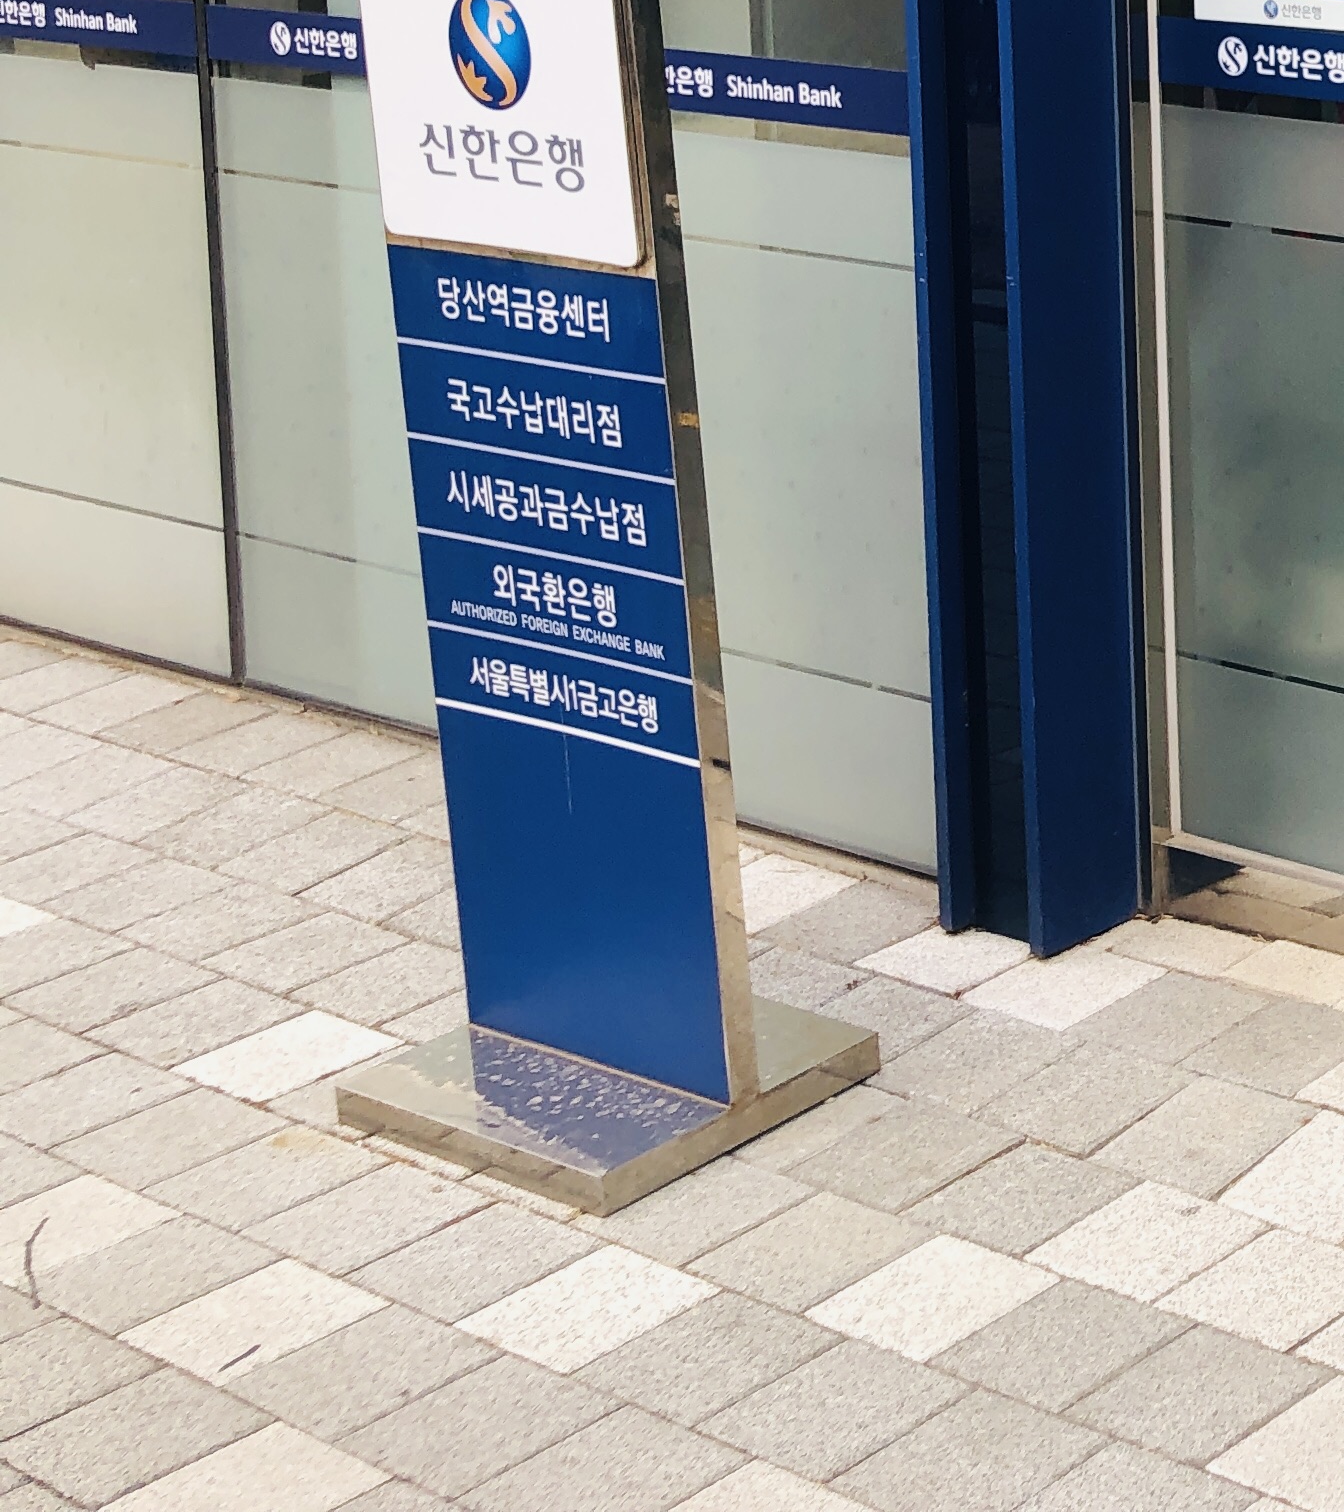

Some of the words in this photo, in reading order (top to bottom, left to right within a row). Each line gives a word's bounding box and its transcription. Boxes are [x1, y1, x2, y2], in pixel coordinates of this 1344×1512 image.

[54, 6, 104, 31] Shinhan
[106, 12, 138, 35] Bank
[294, 27, 358, 60] 신한은행
[1281, 6, 1322, 20] 신한은행
[726, 74, 795, 104] Shinhan
[798, 82, 843, 109] Bank
[419, 122, 586, 193] 신한은행
[437, 276, 611, 343] 당산역금융센터
[447, 377, 623, 449] 국고수납대리점
[447, 470, 647, 548] 시세공과금수납점
[492, 564, 618, 628] 외국환은행
[451, 599, 518, 627] AUTHORIZED
[521, 615, 569, 638] FOREIGN
[572, 624, 631, 652] EXCHANGE
[634, 638, 666, 661] BANK
[470, 656, 659, 734] 서울특별시1금고은행
